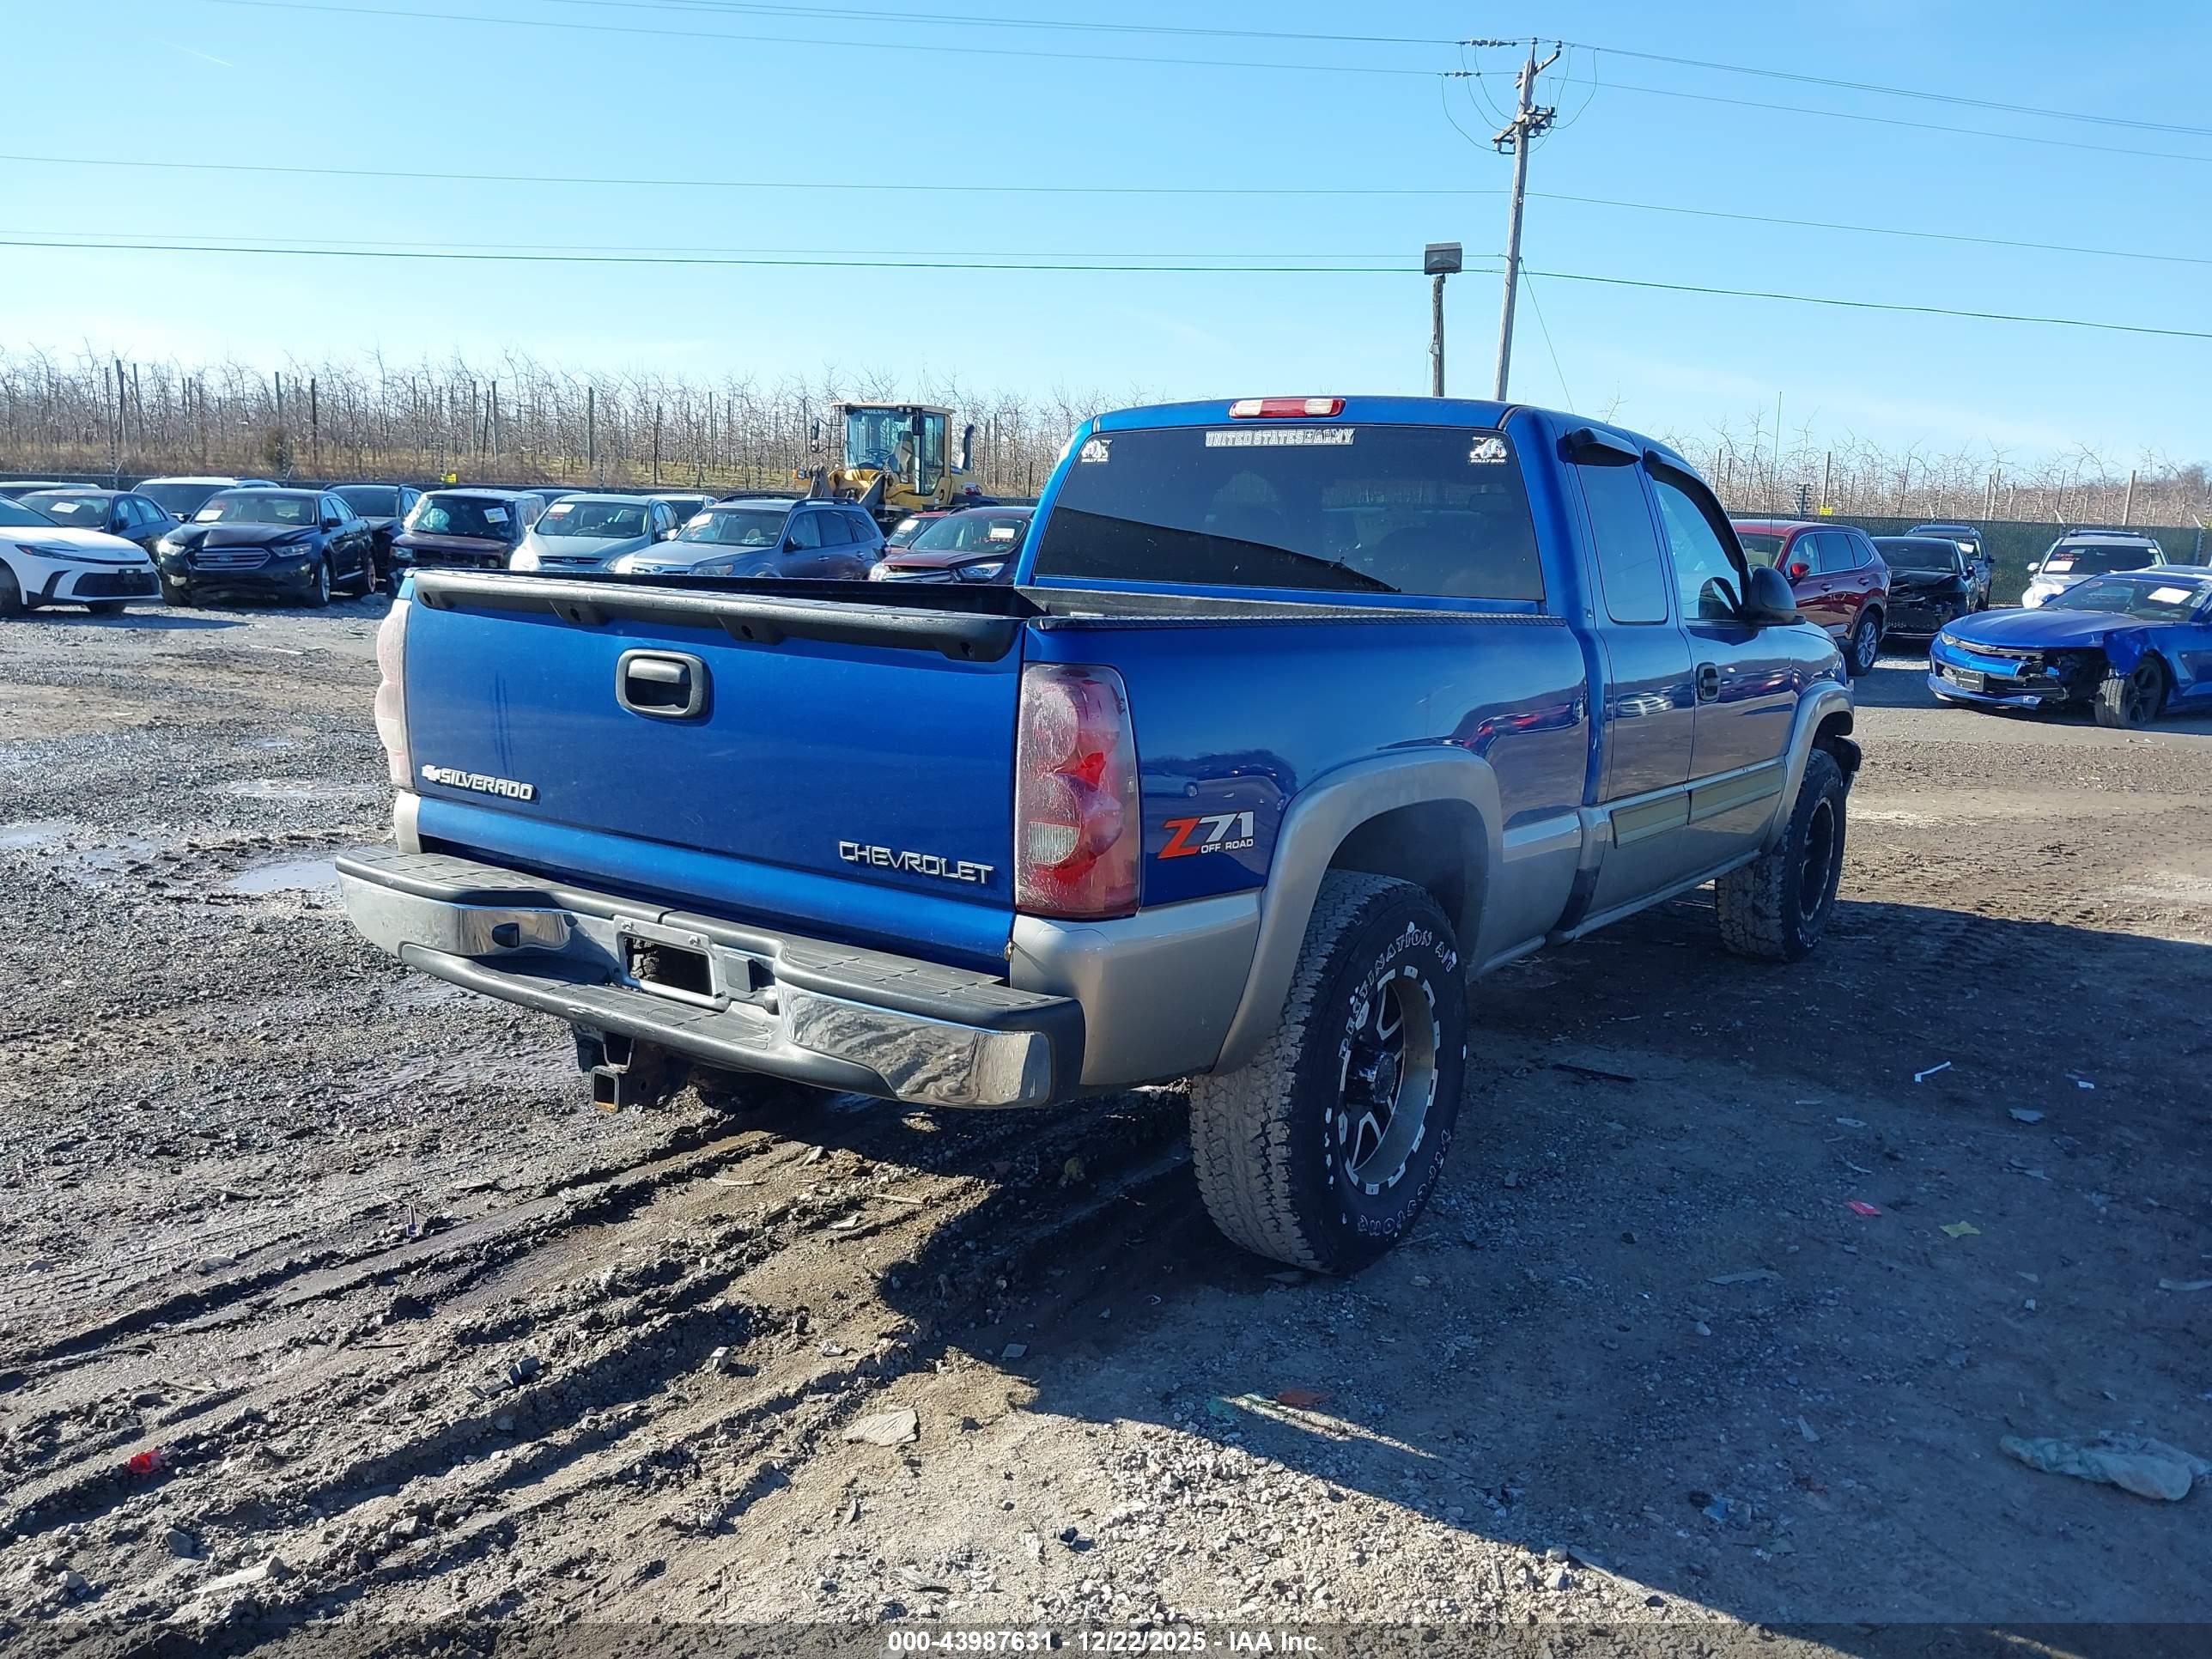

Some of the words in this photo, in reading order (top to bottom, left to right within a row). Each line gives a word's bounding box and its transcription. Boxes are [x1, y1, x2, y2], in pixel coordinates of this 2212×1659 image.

[1206, 431, 1253, 447] UNITED
[1254, 430, 1304, 446] STATES
[1313, 428, 1355, 444] ARMY
[440, 768, 533, 800] SILVERADO
[1157, 811, 1254, 860] Z71
[1200, 842, 1221, 854] OFF
[1225, 838, 1254, 850] ROAD
[839, 841, 994, 884] CHEVROLET
[1338, 928, 1433, 1061] DESTINATION
